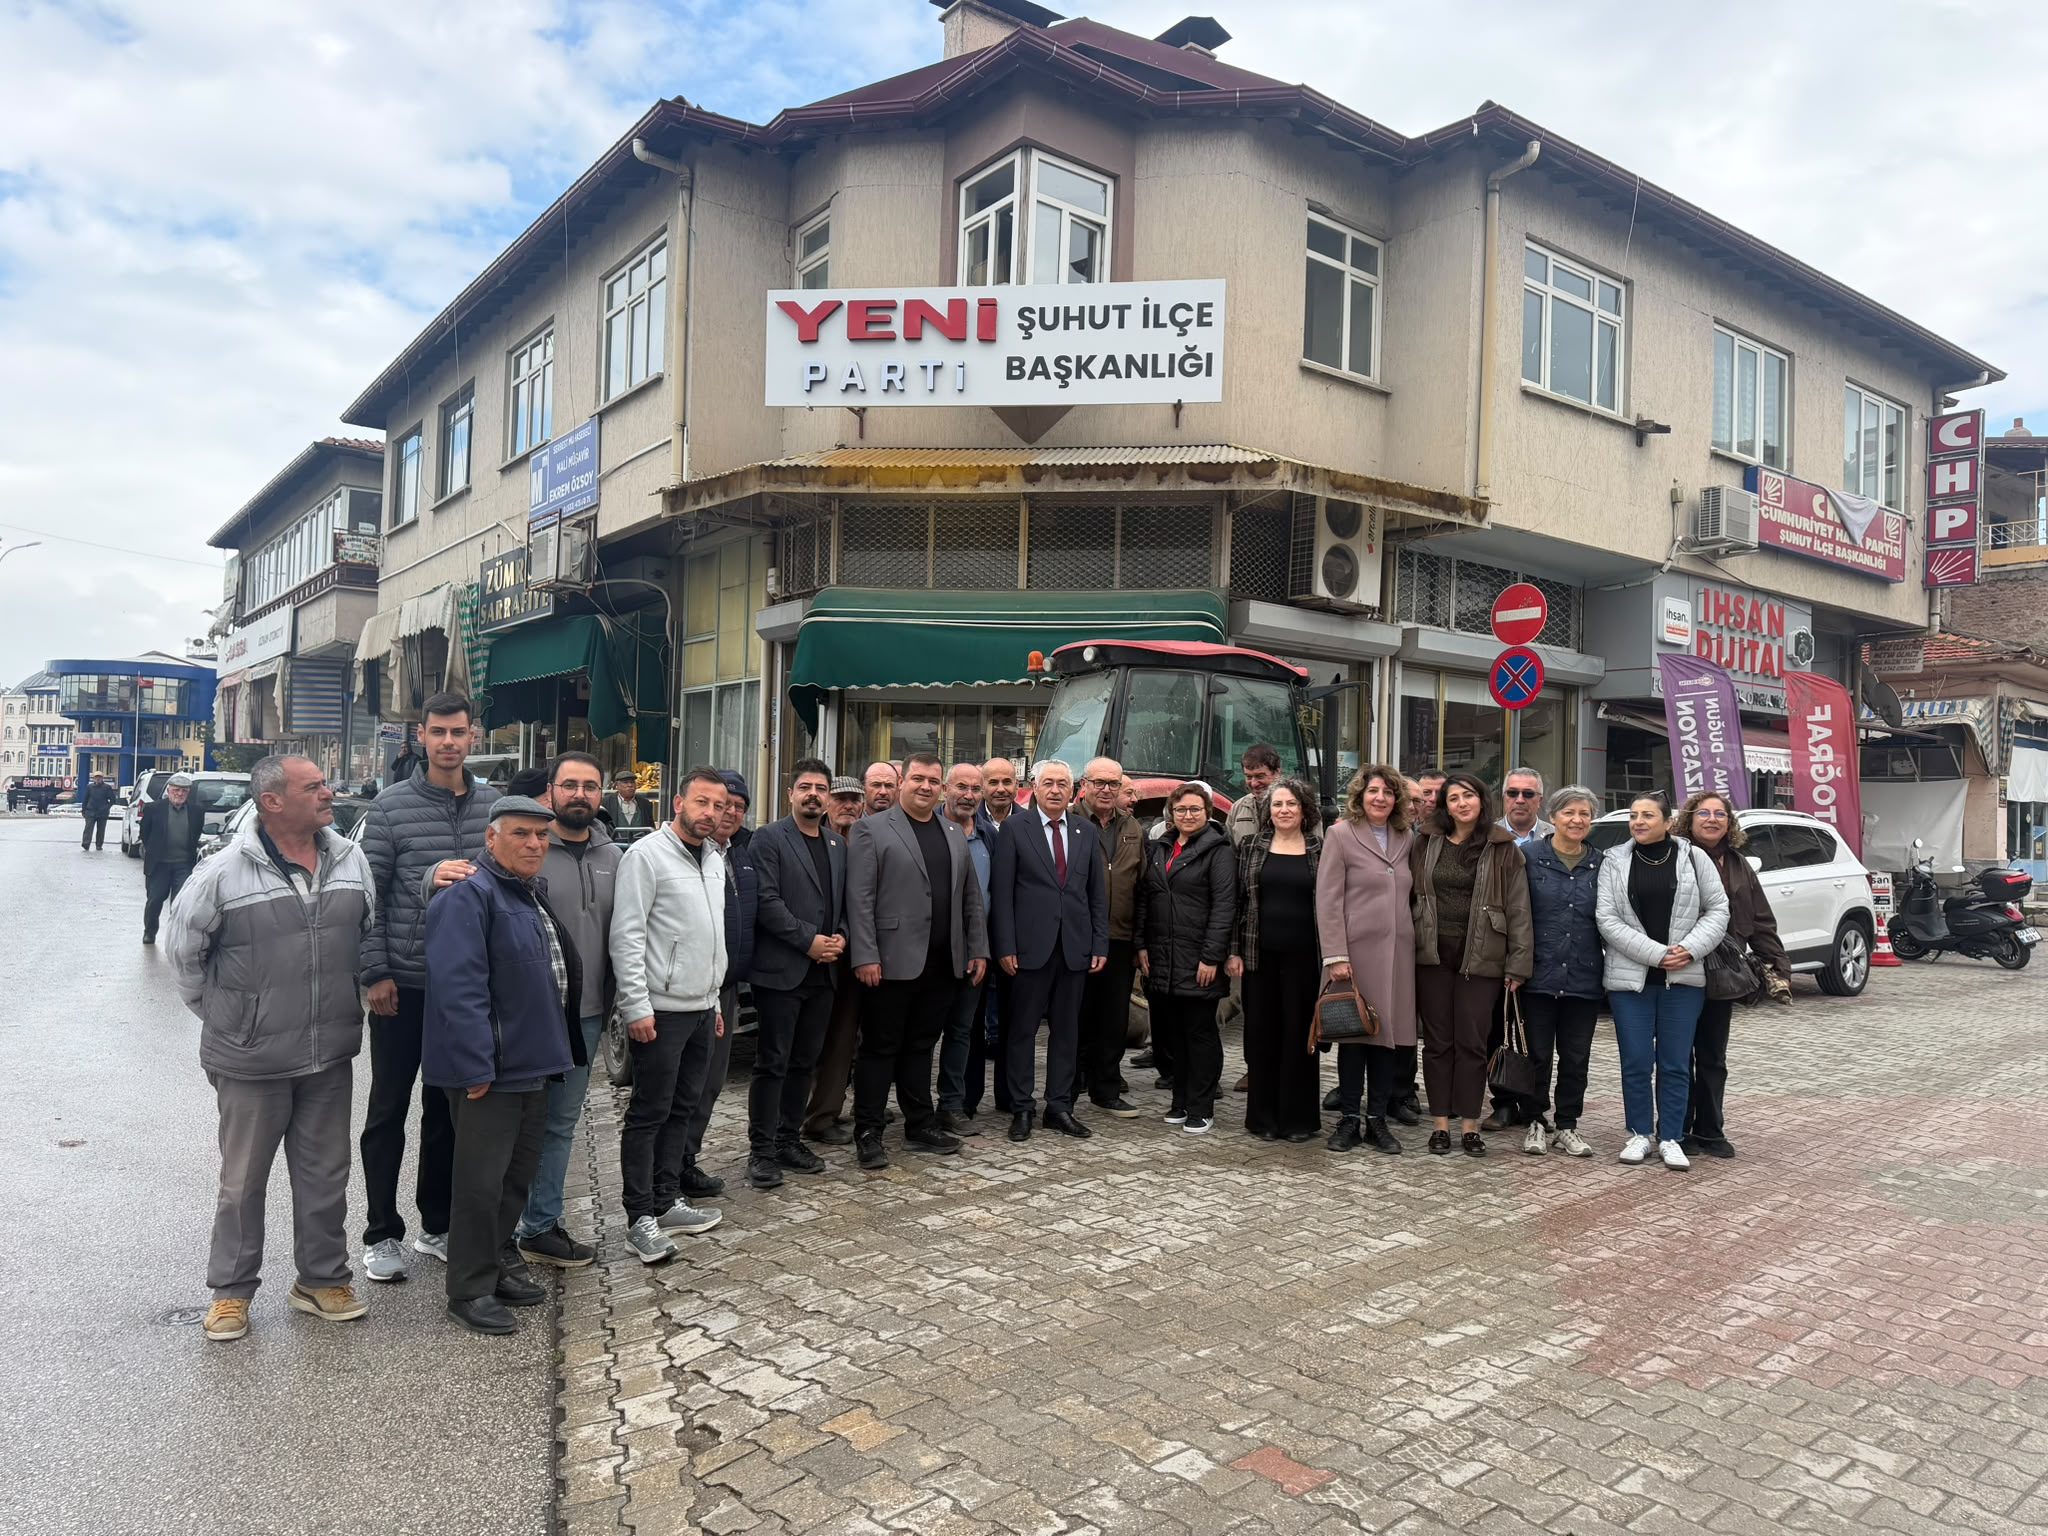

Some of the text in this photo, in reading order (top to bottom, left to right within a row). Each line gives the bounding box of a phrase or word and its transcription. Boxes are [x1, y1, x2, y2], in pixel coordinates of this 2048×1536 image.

[1017, 297, 1214, 340] ŞUHUT İLÇE
[1006, 345, 1213, 388] BAŞKANLIĞI
[549, 470, 594, 503] EKREM ÖZSOY
[1935, 416, 1972, 538] CHP
[1761, 505, 1834, 540] CUMHURİYET
[1866, 536, 1902, 560] PARTİSİ
[1779, 529, 1886, 571] ŞUHUT İLÇE BAŞKANLIĞI
